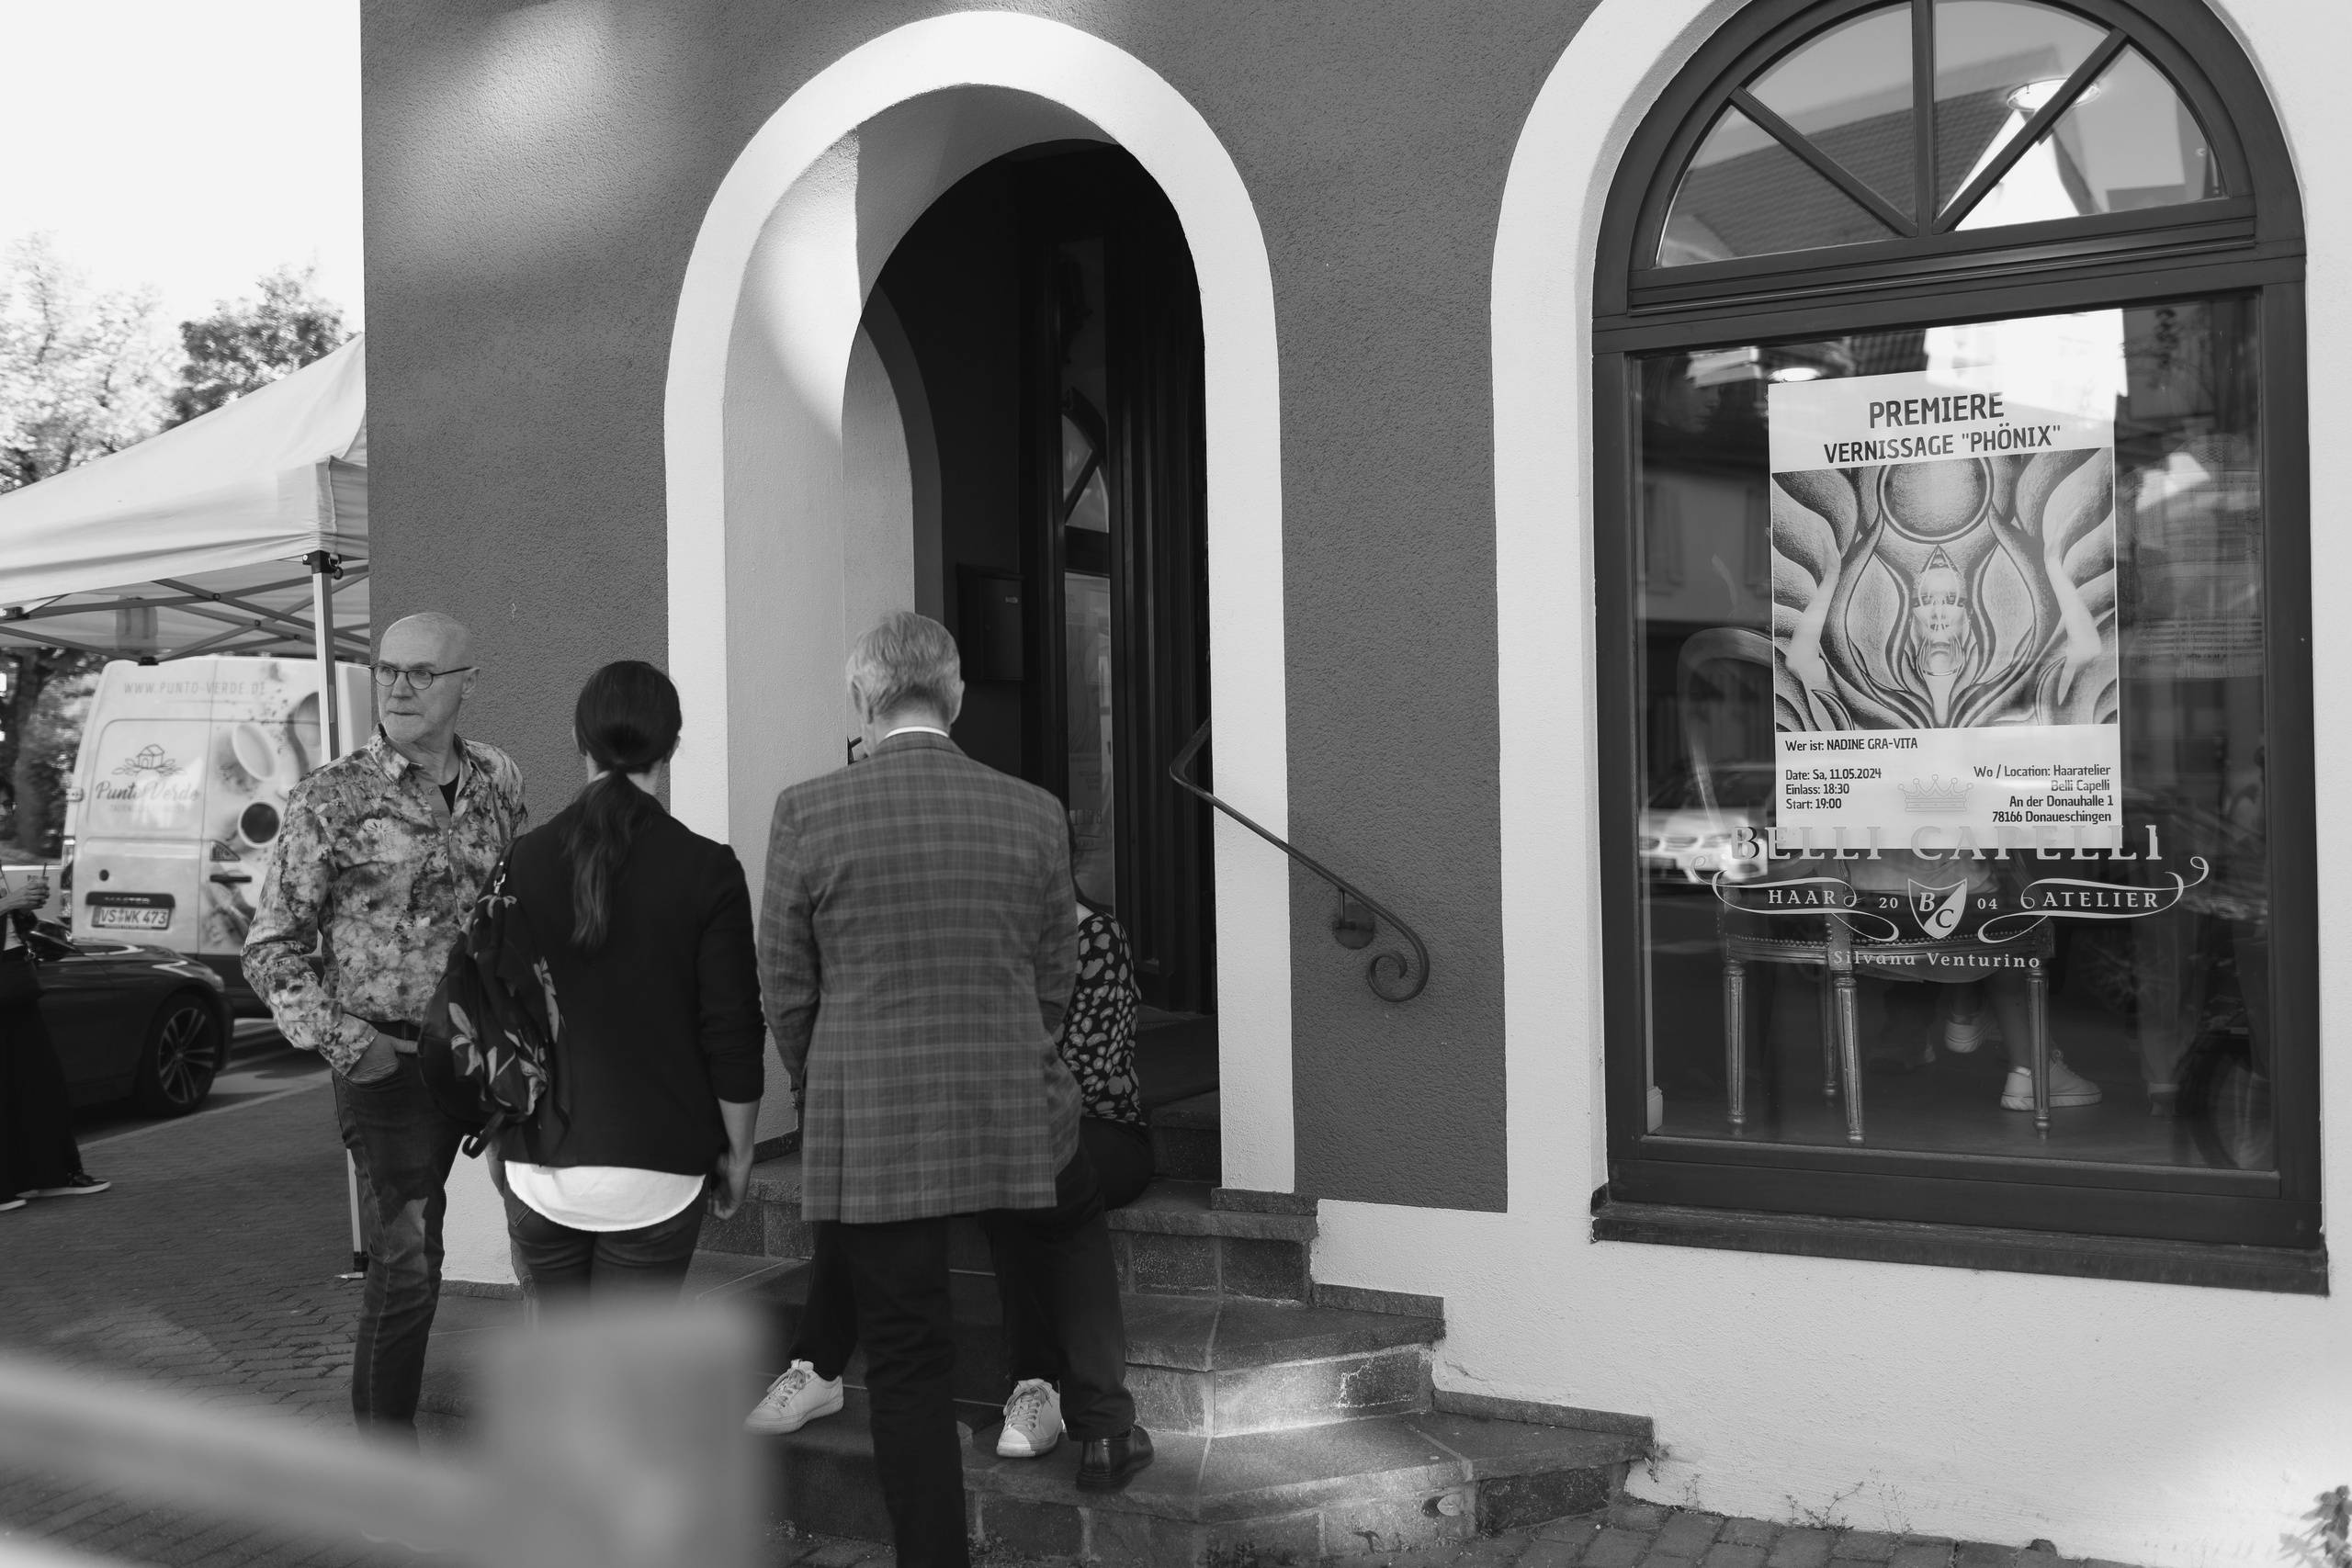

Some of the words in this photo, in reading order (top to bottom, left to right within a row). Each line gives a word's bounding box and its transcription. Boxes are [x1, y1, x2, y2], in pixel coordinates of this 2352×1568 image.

[1870, 392, 2005, 428] PREMIERE
[1823, 434, 1954, 464] VERNISSAGE
[1962, 423, 2062, 453] "PHÖNIX"
[124, 682, 266, 695] WWW.PUNTO-VERDE.DE
[1785, 740, 1807, 751] Wer
[1810, 739, 1825, 750] ist:
[1826, 739, 1865, 750] NADINE
[1868, 738, 1918, 750] GRA-VITA
[1786, 769, 1810, 781] Date:
[1813, 769, 1827, 781] Sa,
[1829, 768, 1882, 780] 11.05.2024
[1973, 766, 1994, 778] Wo
[2004, 765, 2051, 777] Location:
[2053, 764, 2110, 776] Haaratelier
[96, 780, 141, 800] Punto
[142, 781, 200, 801] Verde
[1786, 784, 1821, 795] Einlass:
[1824, 784, 1849, 795] 18:30
[2051, 779, 2074, 792] Belli
[2076, 779, 2110, 794] Capelli
[1786, 798, 1813, 809] Start:
[1815, 798, 1842, 809] 19:00
[2009, 795, 2023, 807] An
[2026, 795, 2044, 807] der
[2046, 795, 2105, 807] Donauhalle
[2107, 795, 2114, 807] 1
[1992, 811, 2022, 823] 78166
[2025, 810, 2112, 825] Donaueschingen
[1731, 826, 1882, 860] BELLI
[1910, 825, 2162, 860] CAPELLI
[1768, 889, 1837, 905] HAAR
[1879, 897, 1899, 909] 20
[1977, 897, 1998, 909] 04
[2042, 892, 2158, 908] ATELIER
[143, 912, 166, 924] 473
[1834, 950, 1916, 966] Silvana
[1927, 953, 2040, 968] Venturino
